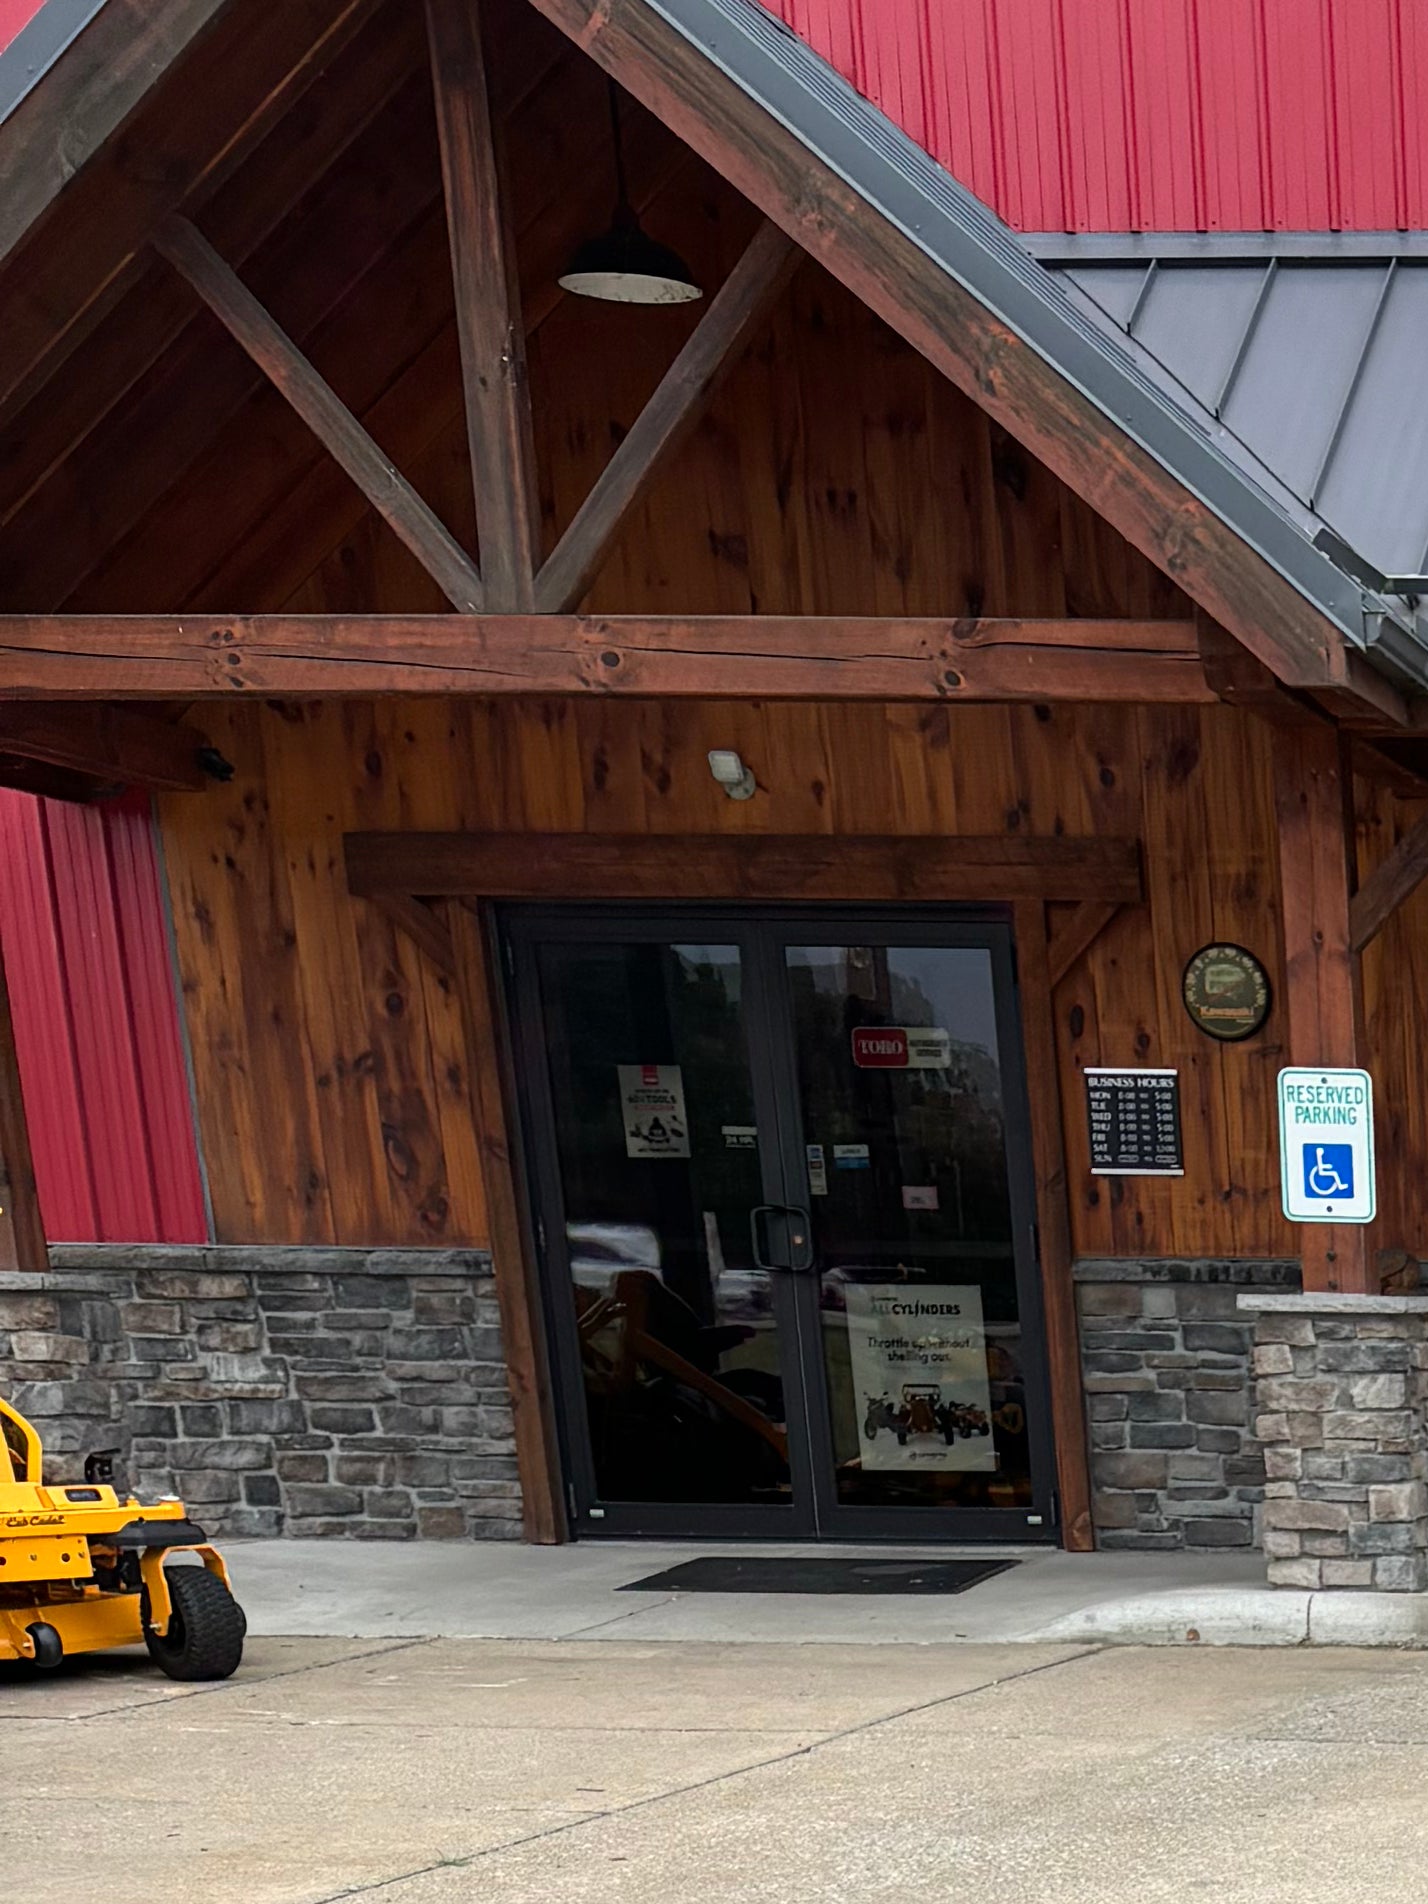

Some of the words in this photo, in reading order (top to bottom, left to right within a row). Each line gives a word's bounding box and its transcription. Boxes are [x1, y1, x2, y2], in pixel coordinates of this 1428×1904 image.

[858, 1039, 903, 1055] TORO
[1088, 1077, 1134, 1087] BUSINESS
[1137, 1078, 1174, 1088] HOURS
[1287, 1085, 1363, 1104] RESERVED
[1295, 1107, 1357, 1125] PARKING
